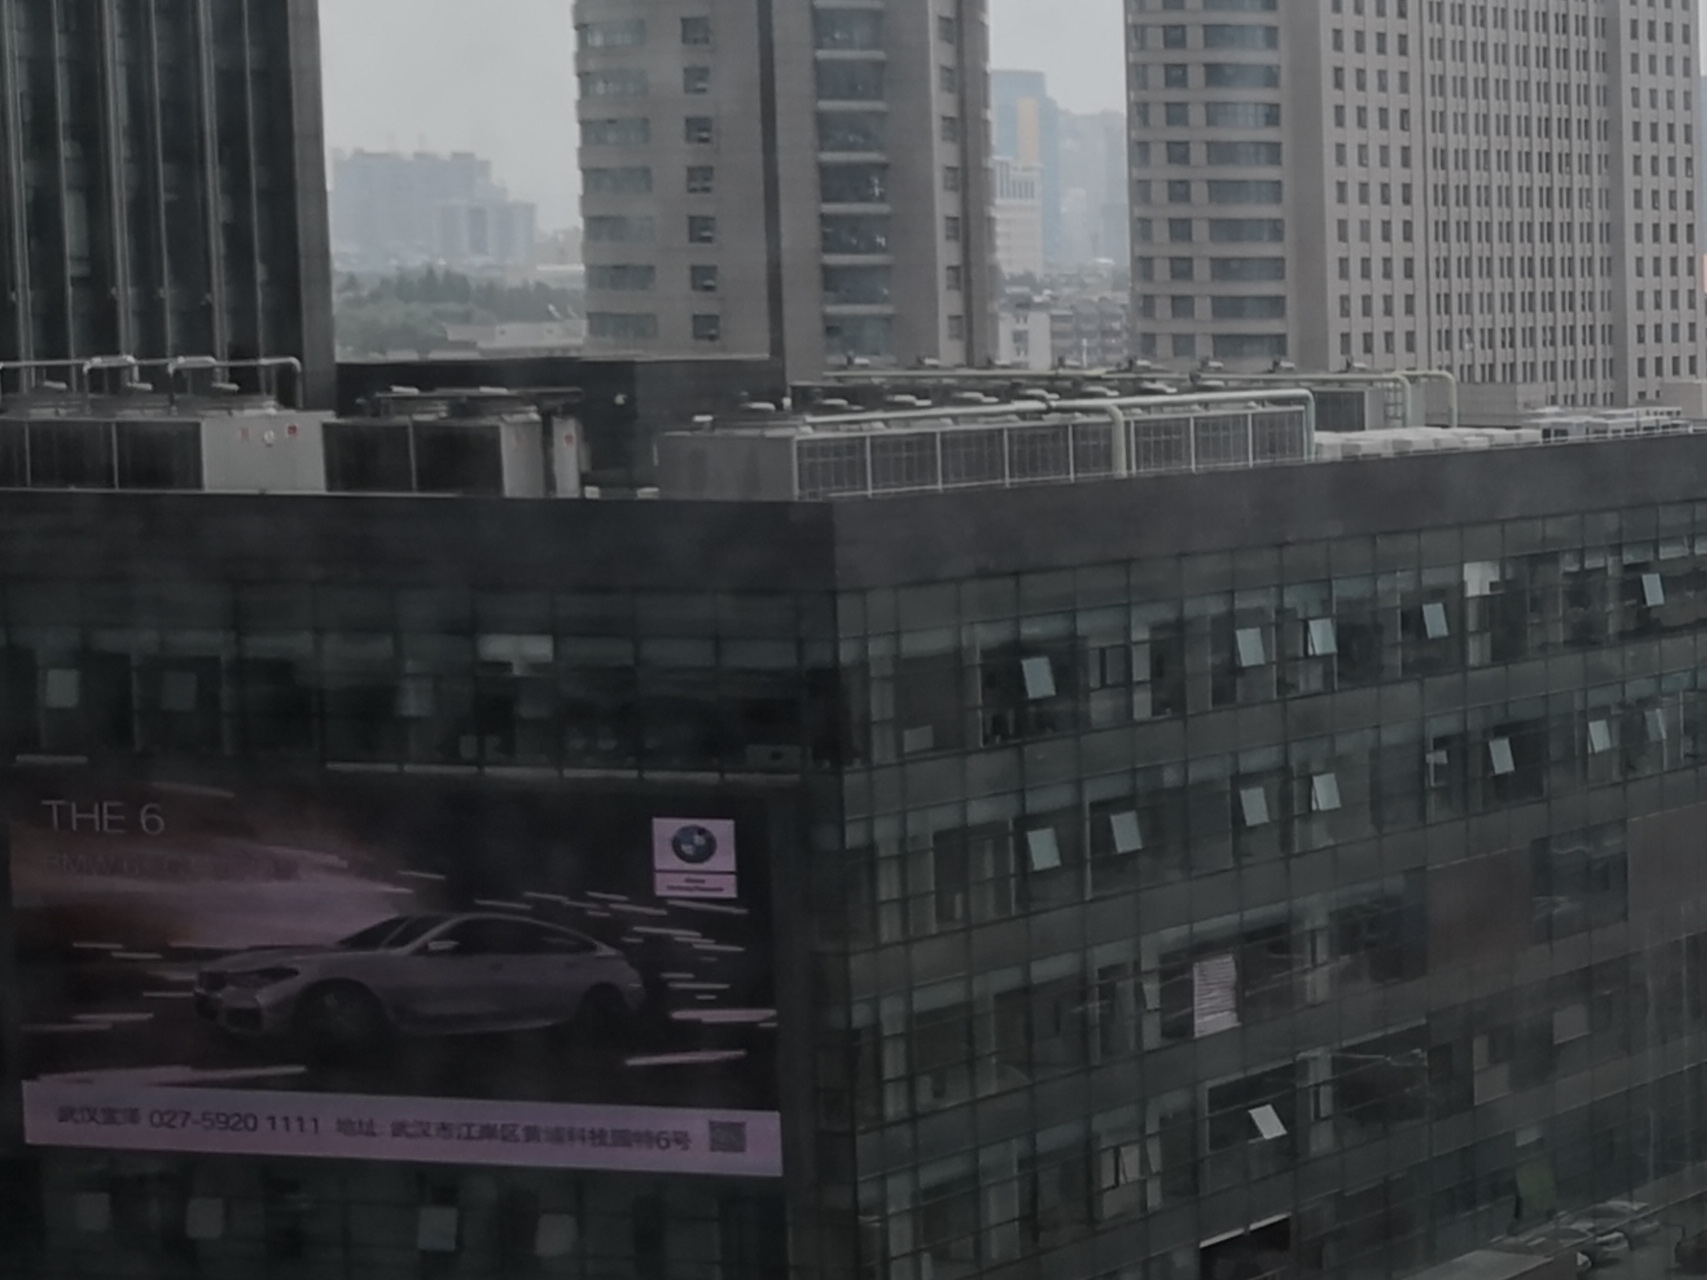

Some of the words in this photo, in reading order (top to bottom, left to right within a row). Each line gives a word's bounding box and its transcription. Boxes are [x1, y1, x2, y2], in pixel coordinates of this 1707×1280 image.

[41, 799, 127, 835] THE
[140, 802, 166, 836] 6
[149, 1110, 258, 1134] 027-5920
[266, 1115, 320, 1136] 1111
